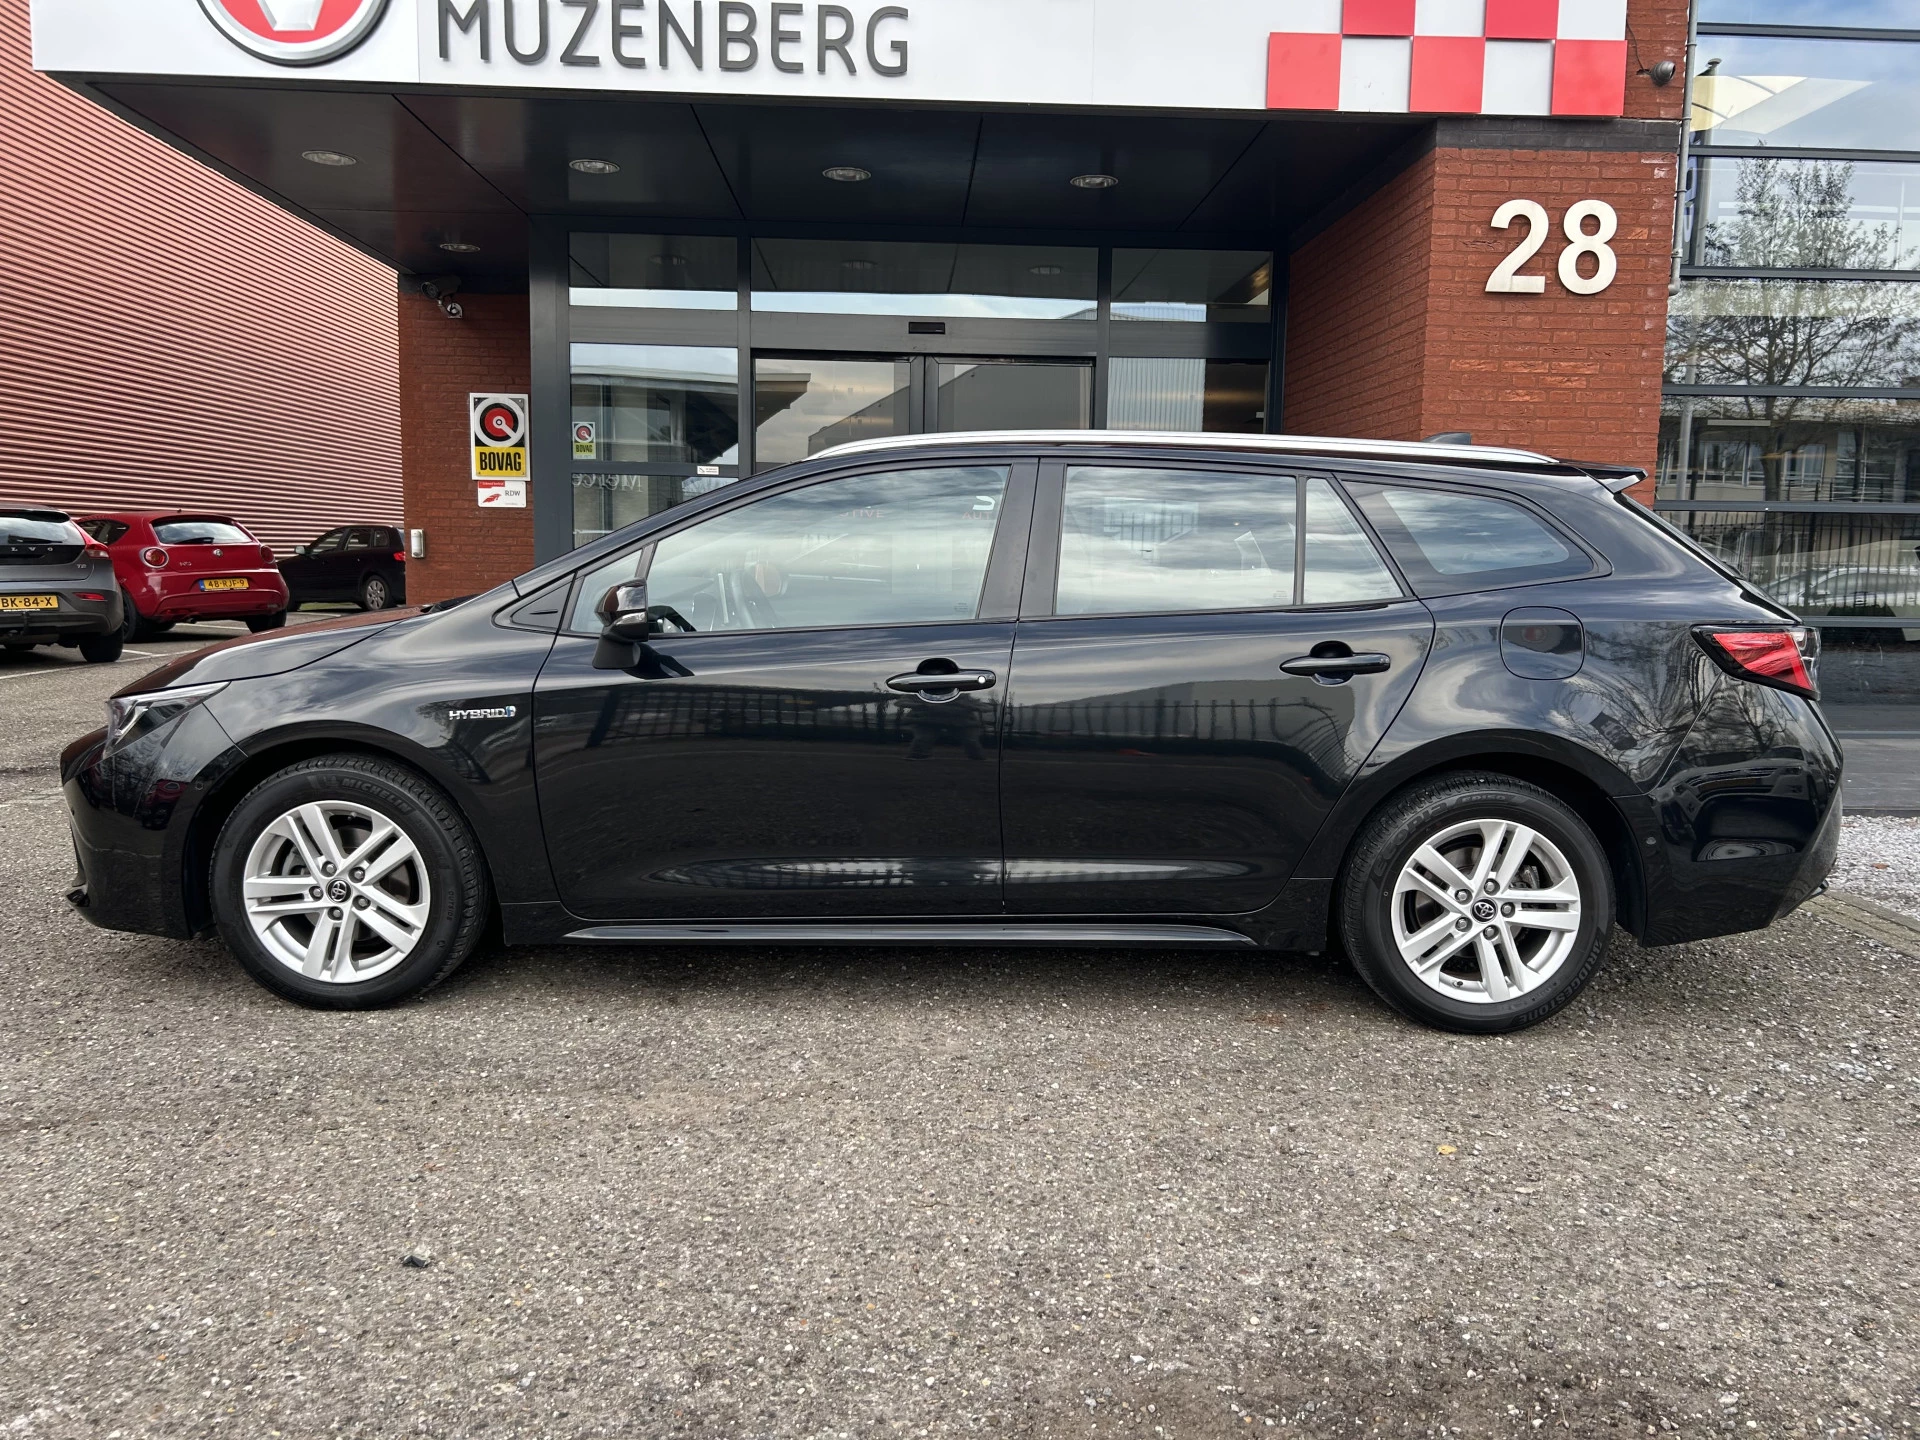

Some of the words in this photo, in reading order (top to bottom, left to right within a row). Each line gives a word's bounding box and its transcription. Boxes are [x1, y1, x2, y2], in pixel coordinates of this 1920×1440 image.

[438, 0, 909, 77] MUZENBERG
[1485, 199, 1618, 295] 28
[479, 451, 522, 472] BOVAG
[575, 444, 593, 453] BOVAG
[208, 579, 245, 589] 48-RJF-9
[448, 707, 507, 721] HYBRID
[341, 777, 414, 814] MICHELIN
[1518, 937, 1603, 1026] BRIDGESTONE
